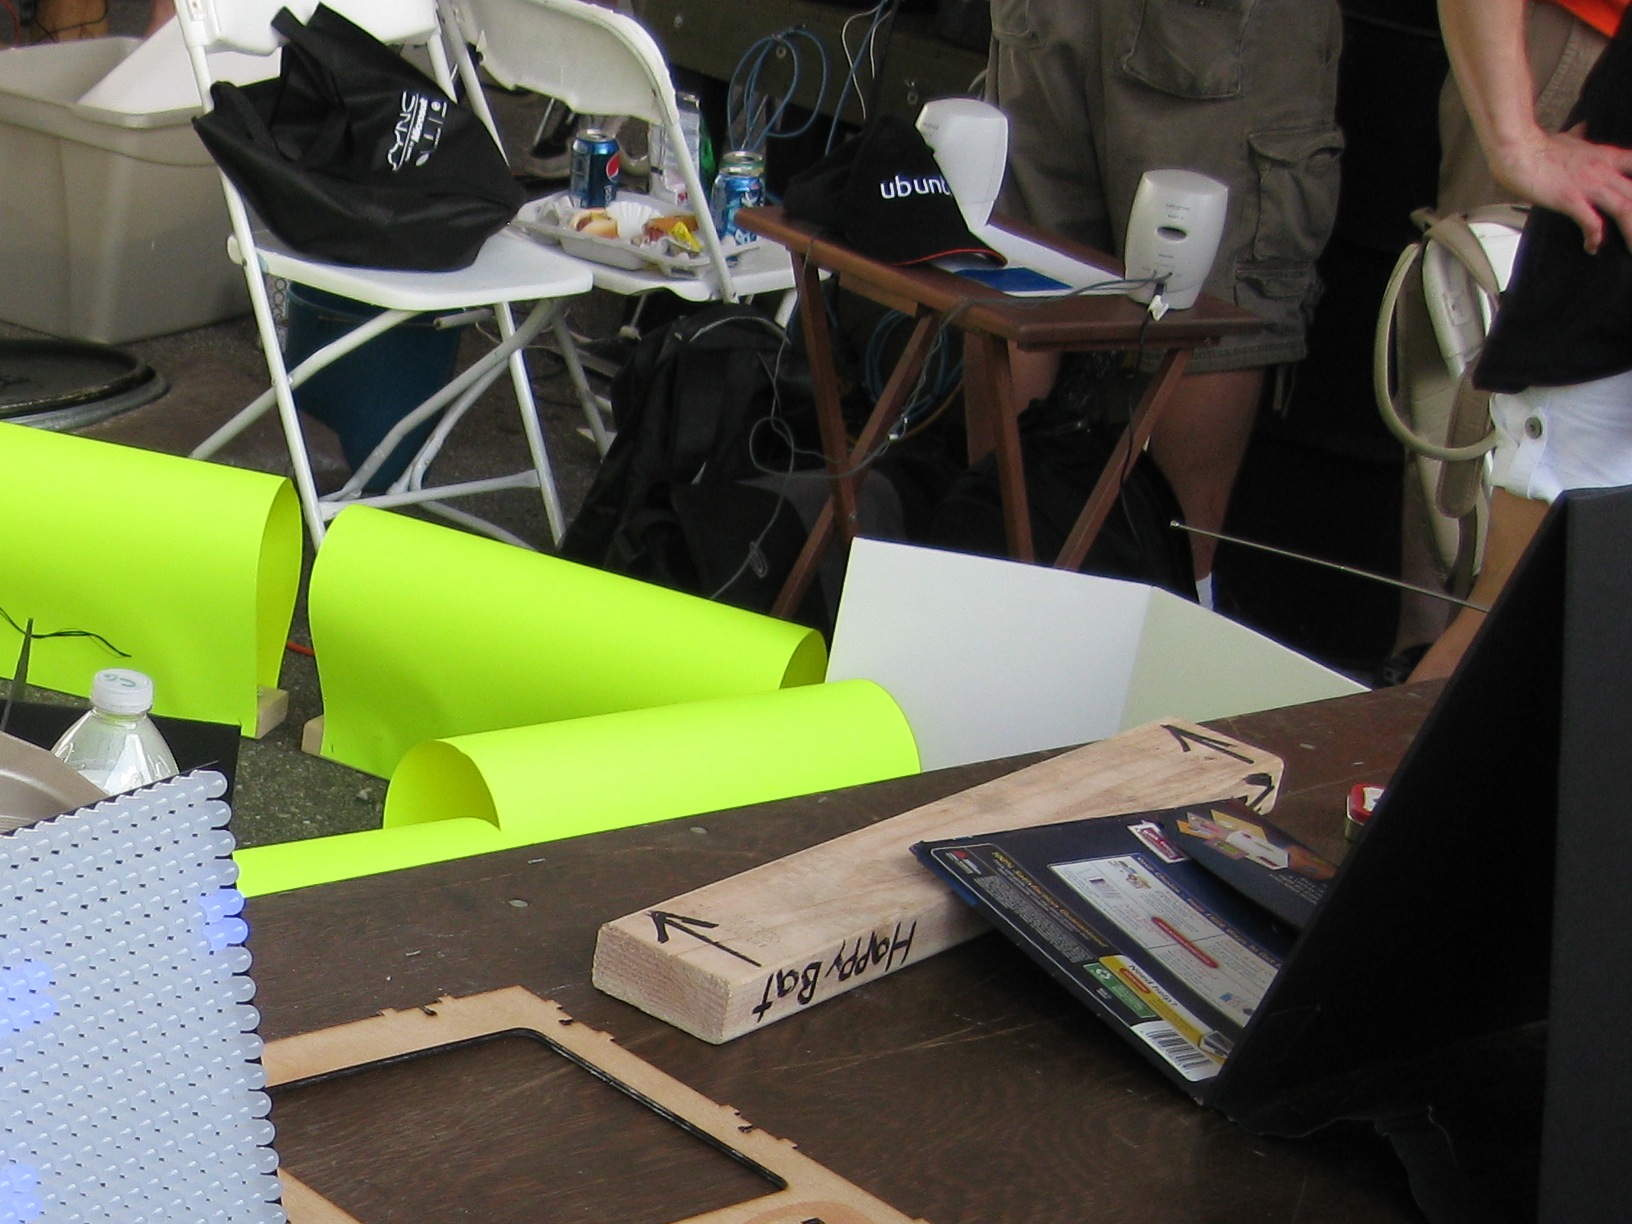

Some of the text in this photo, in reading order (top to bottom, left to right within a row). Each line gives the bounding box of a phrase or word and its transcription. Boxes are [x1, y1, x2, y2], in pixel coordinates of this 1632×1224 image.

[880, 174, 953, 199] ubunt
[824, 919, 918, 983] Happy
[752, 960, 823, 1024] Bat
